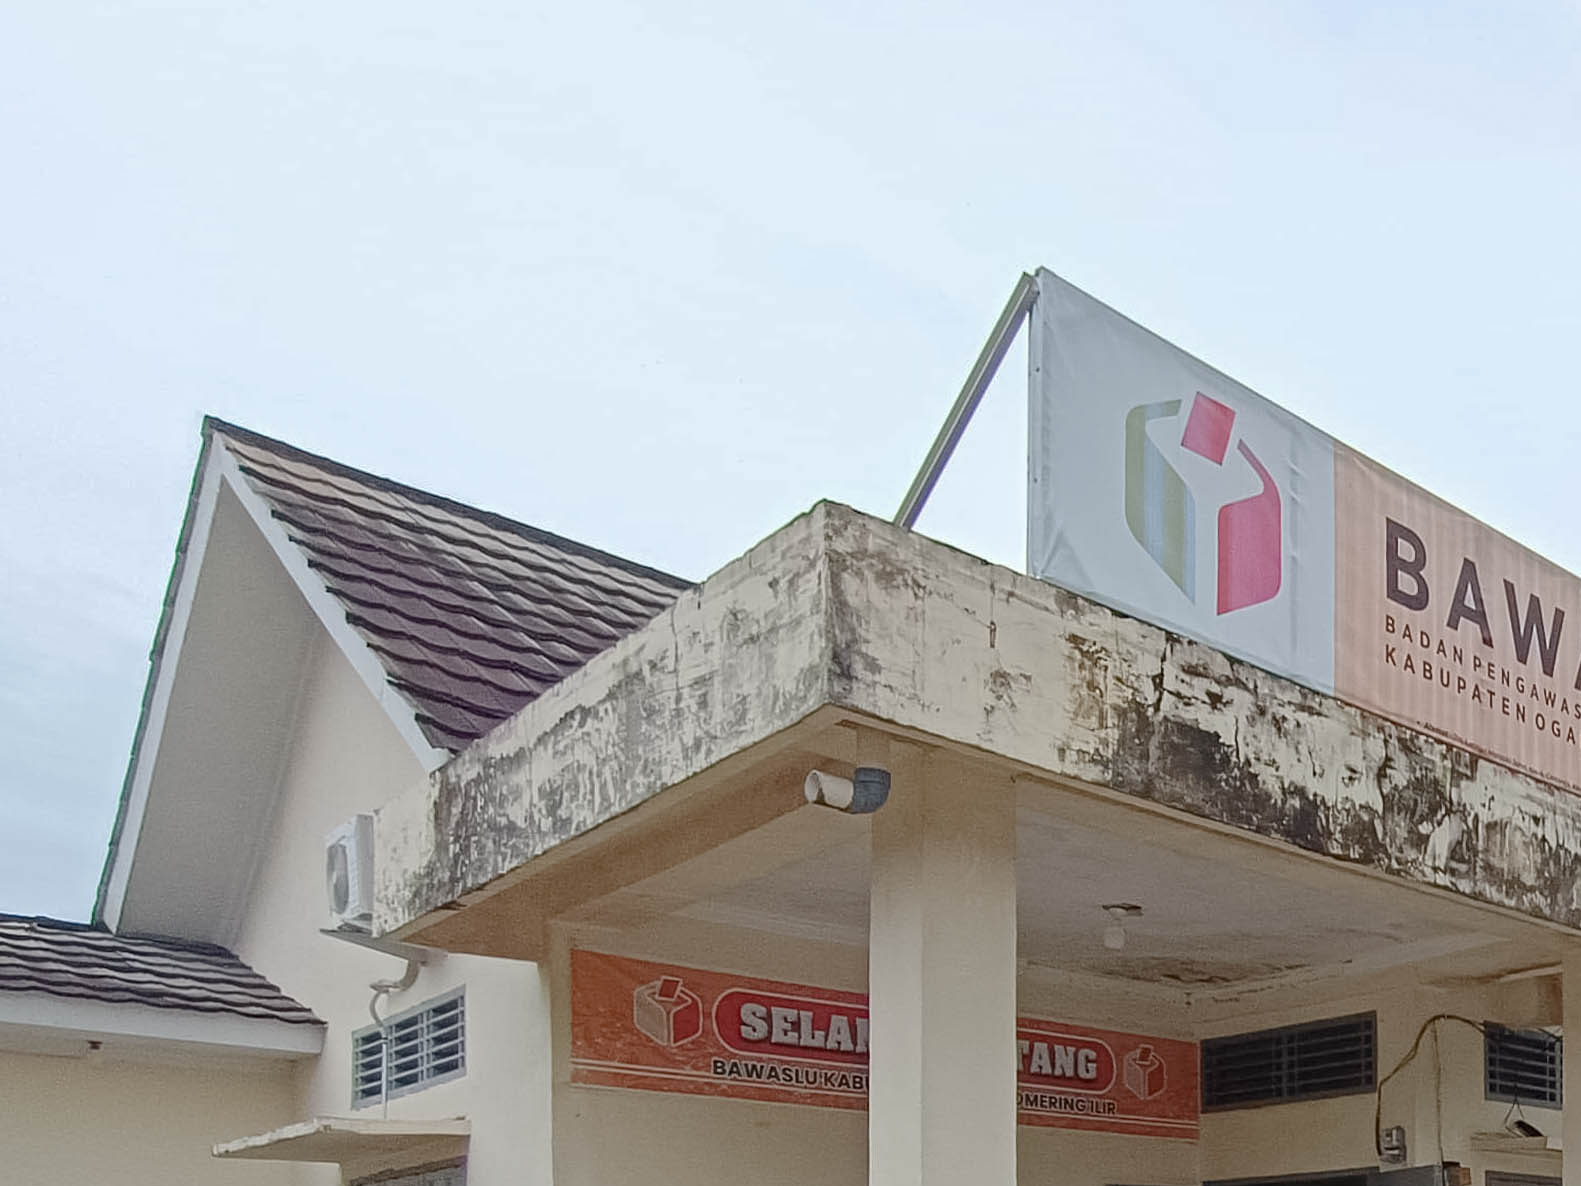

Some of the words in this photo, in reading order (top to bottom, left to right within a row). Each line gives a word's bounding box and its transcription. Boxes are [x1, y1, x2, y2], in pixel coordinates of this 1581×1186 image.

[1385, 614, 1463, 665] BADAN
[1473, 655, 1581, 720] PENGAWAS
[1385, 644, 1526, 723] KABUPATEN
[712, 1059, 818, 1085] BAWASLU
[824, 1071, 868, 1090] KAB
[1017, 1040, 1097, 1080] TANG
